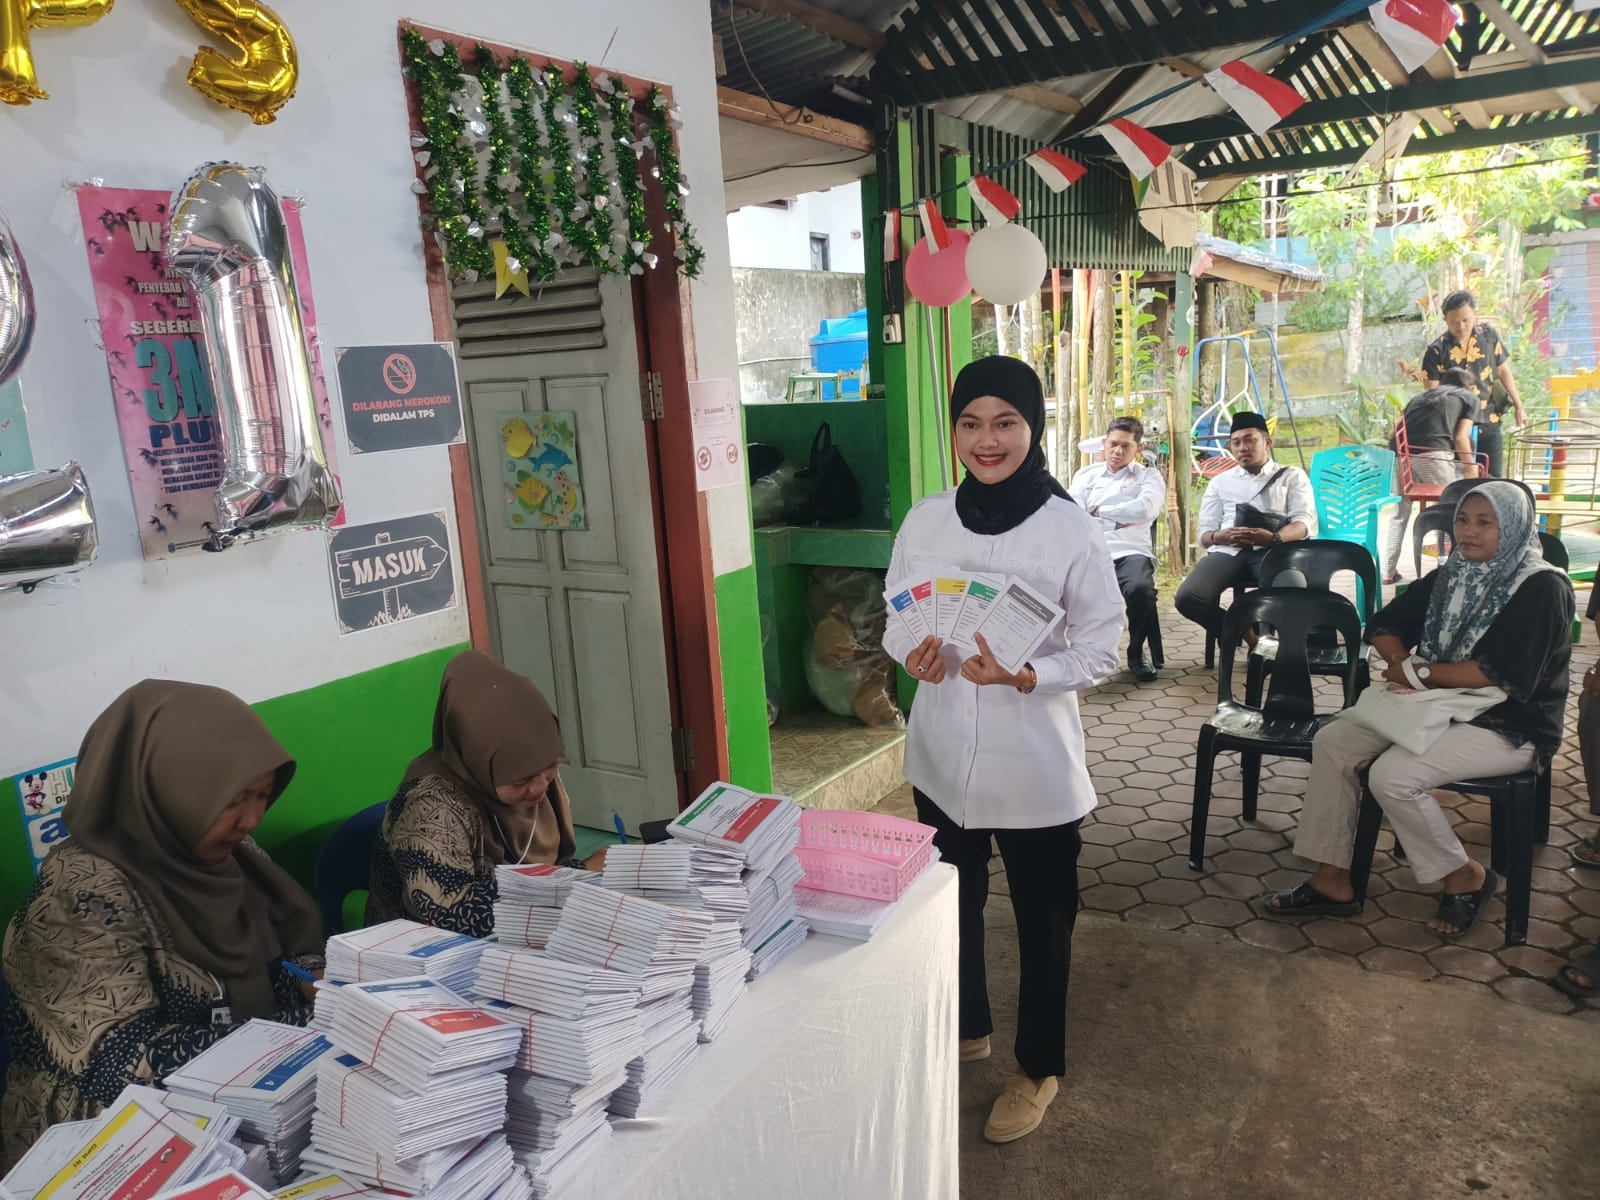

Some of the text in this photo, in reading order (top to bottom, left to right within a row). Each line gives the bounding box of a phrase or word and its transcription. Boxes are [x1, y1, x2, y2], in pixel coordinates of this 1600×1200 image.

[352, 395, 451, 412] DILARANG MEROKOK!
[372, 408, 435, 423] DIDALAM TPS
[149, 421, 213, 448] PLU
[352, 547, 427, 585] MASUK
[82, 1143, 97, 1159] DPR
[133, 1168, 158, 1193] SURAT
